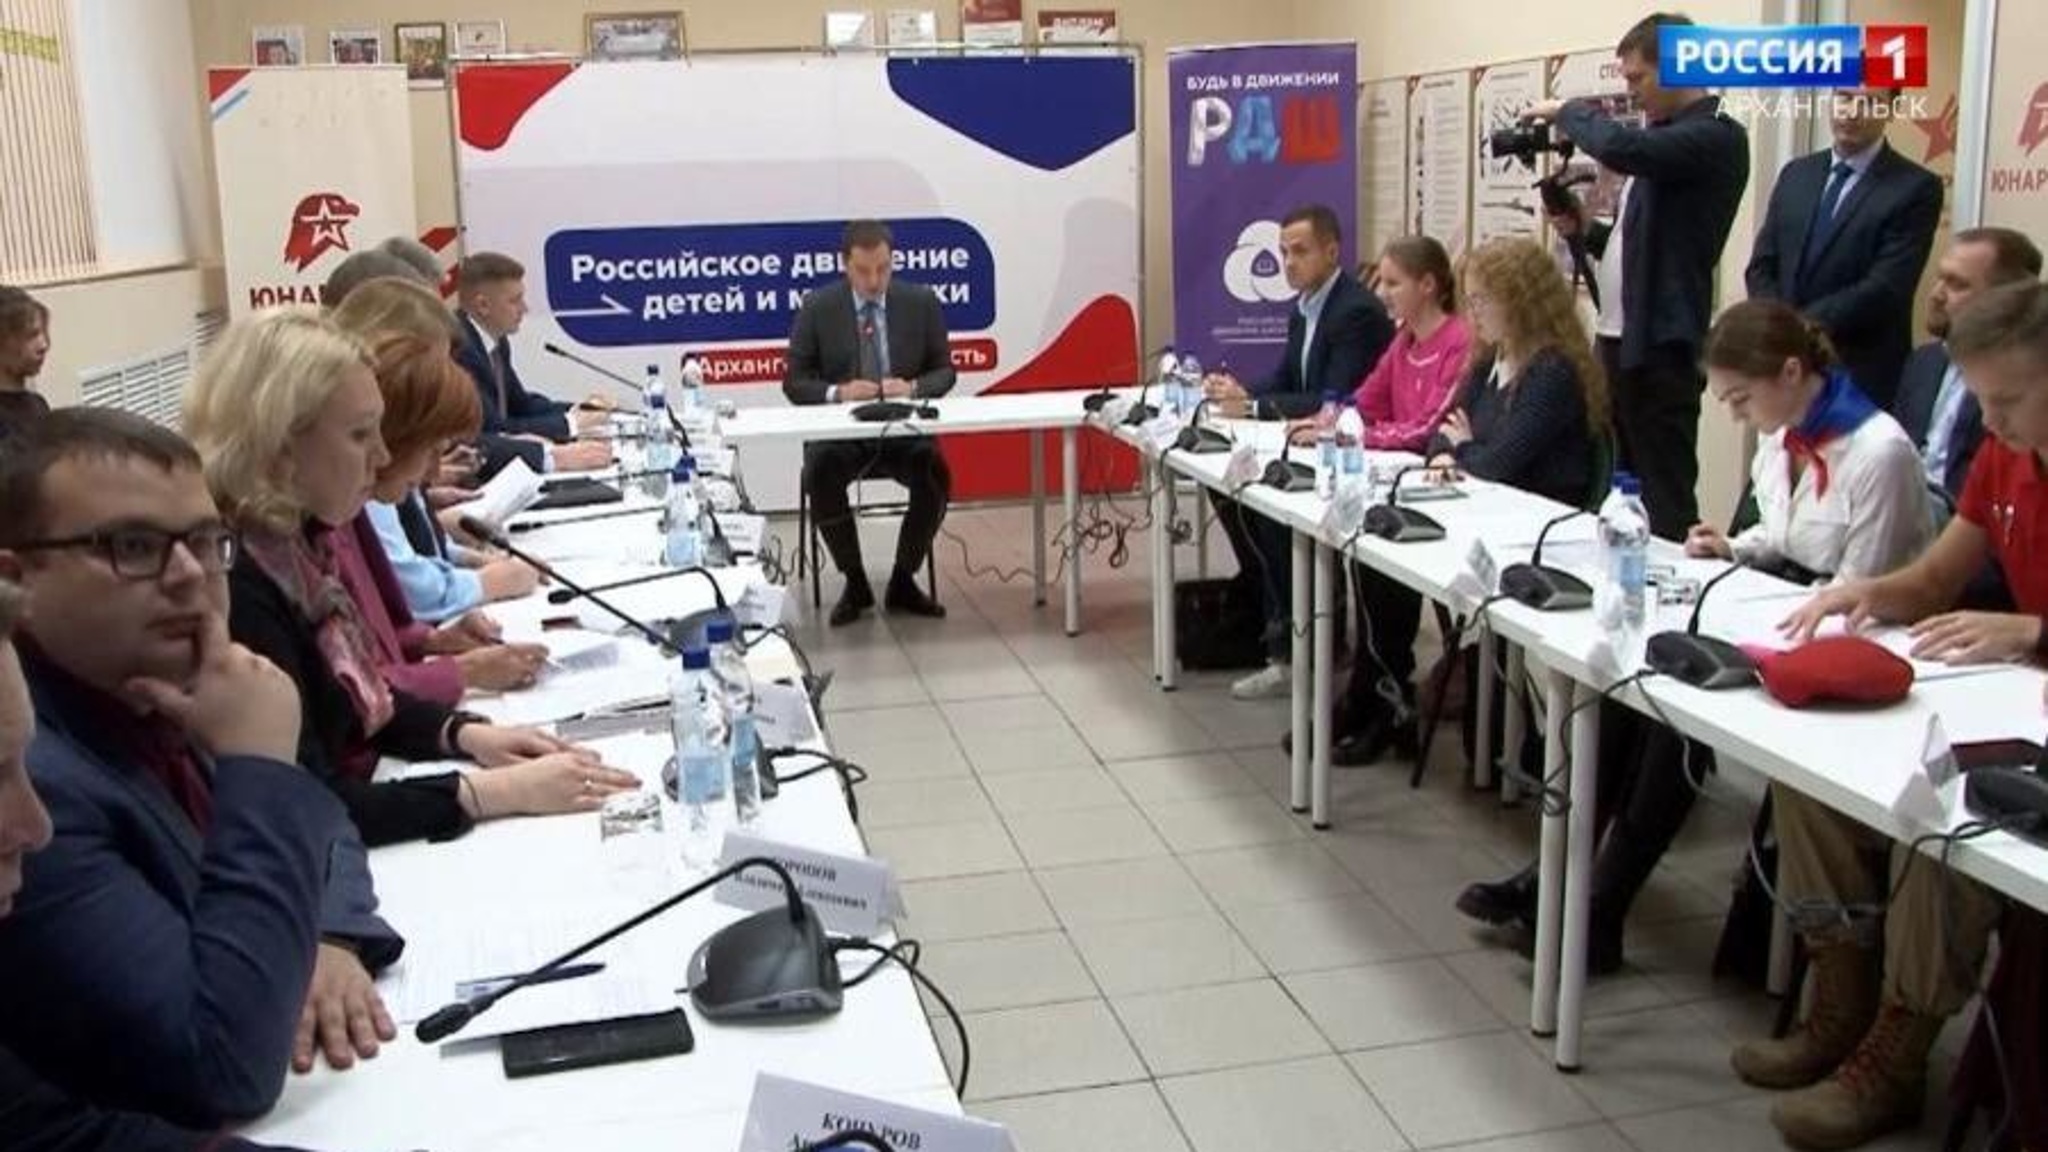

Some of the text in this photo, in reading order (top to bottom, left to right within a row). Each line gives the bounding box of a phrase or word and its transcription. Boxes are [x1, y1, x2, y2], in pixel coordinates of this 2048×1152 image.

[1186, 72, 1340, 91] БУДЬ В ДВИЖЕНИИ
[1187, 96, 1342, 166] РДШ
[571, 250, 781, 282] Российское
[643, 285, 745, 321] детей
[756, 291, 777, 311] и
